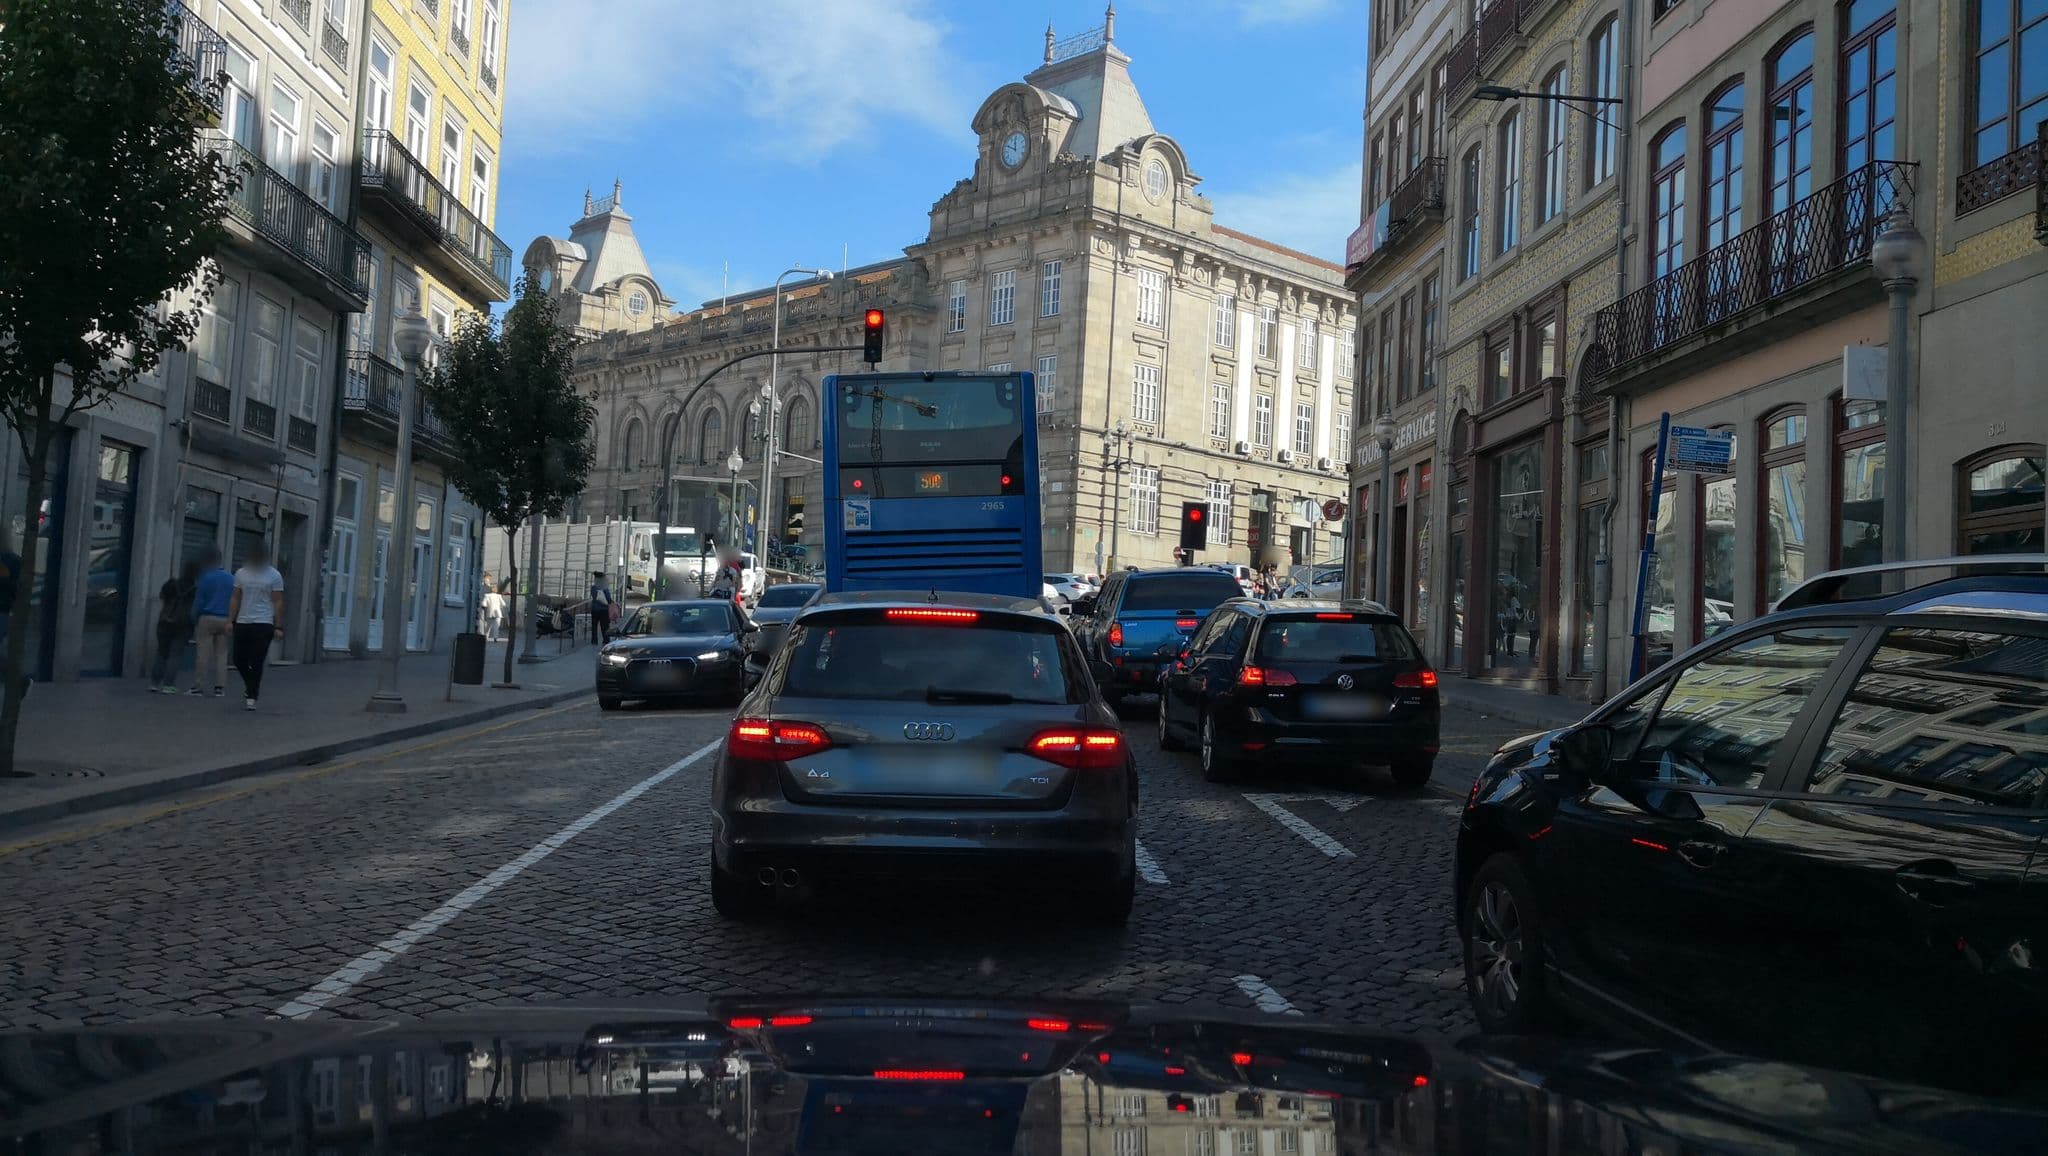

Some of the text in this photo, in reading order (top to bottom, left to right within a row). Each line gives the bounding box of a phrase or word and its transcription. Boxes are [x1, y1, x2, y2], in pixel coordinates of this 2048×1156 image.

[1394, 411, 1436, 451] SERVICE
[982, 502, 1004, 510] 2965
[807, 768, 829, 778] A4
